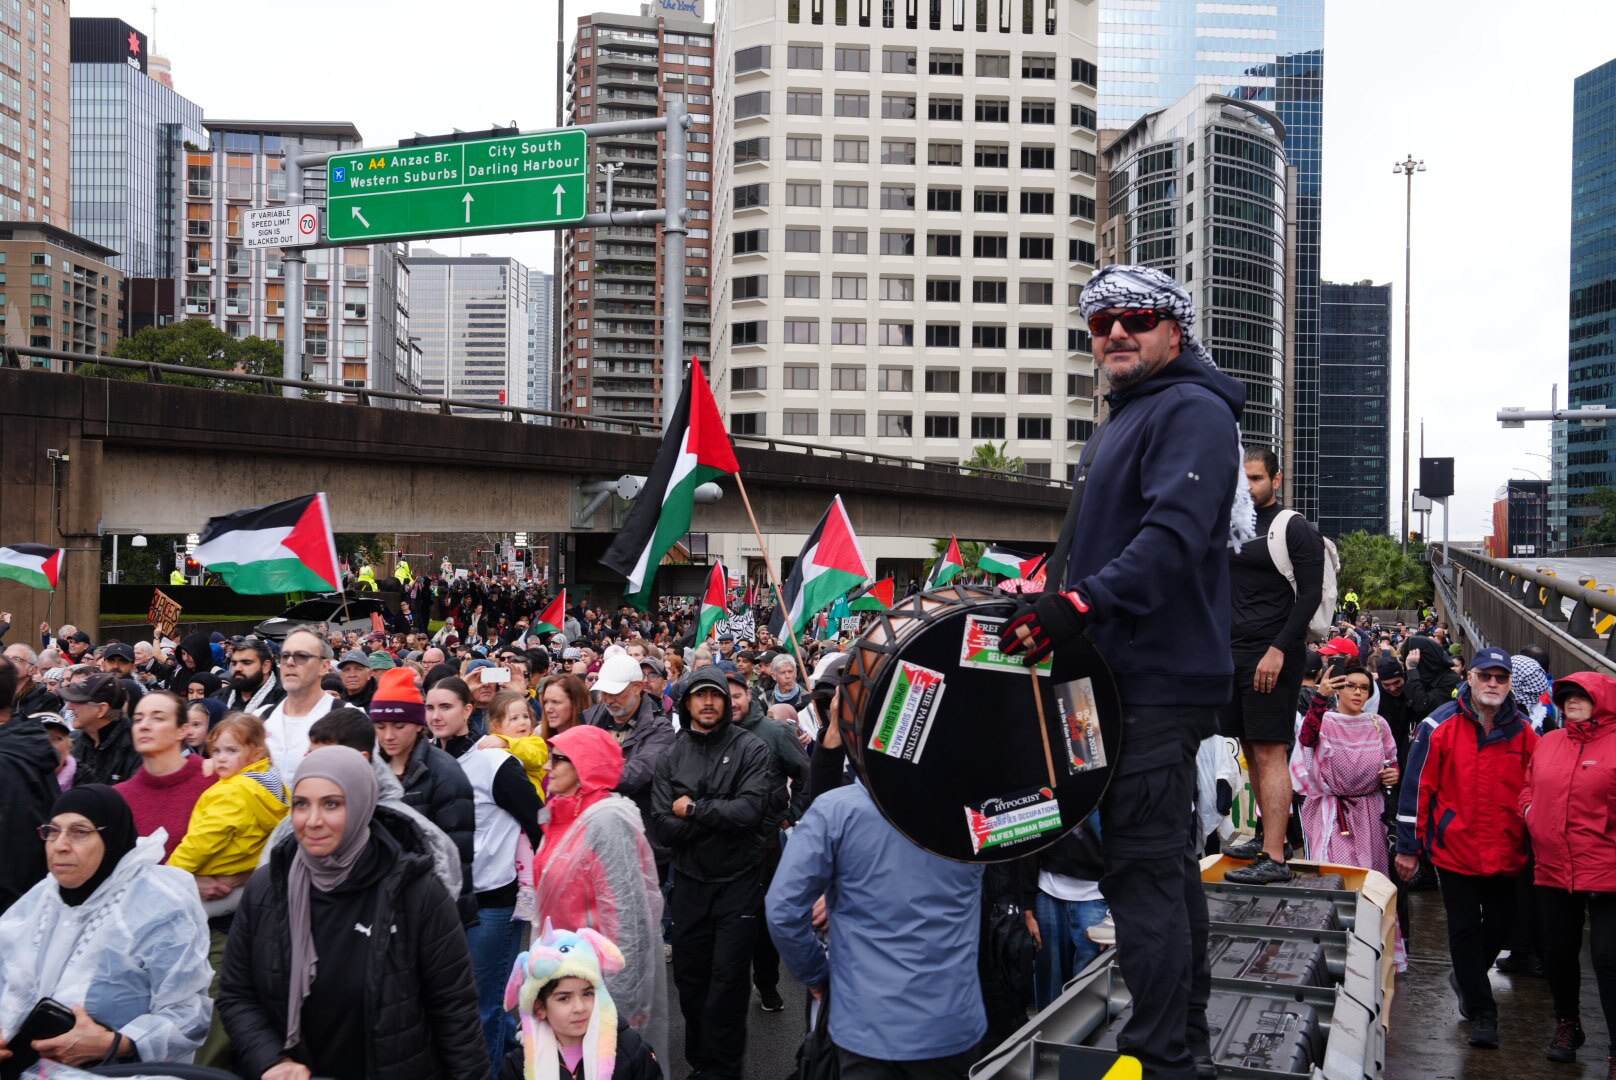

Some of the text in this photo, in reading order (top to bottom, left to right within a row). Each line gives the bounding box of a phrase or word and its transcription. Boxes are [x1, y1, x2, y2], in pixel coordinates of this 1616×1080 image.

[488, 139, 562, 158] City South
[350, 151, 452, 171] To A4 Anzac Br.
[469, 157, 580, 176] Darling Harbour
[350, 168, 457, 188] Western Suburbs
[251, 218, 290, 228] SPEED LIMIT
[258, 209, 291, 219] VARIABLE
[302, 219, 314, 229] 70
[248, 235, 293, 246] BLACKED OUT
[879, 683, 907, 746] UPHOLD EQUALITY
[1057, 697, 1067, 714] Break
[902, 681, 938, 761] FREE PALESTINE
[891, 713, 912, 756] SUPREMACY
[1088, 737, 1098, 755] 2023
[994, 793, 1041, 812] HYPOCRISY
[1018, 803, 1059, 819] OCCUPATIONS
[987, 816, 1062, 843] VILIFIES HUMAN RIGHTS
[1000, 832, 1042, 848] FREE PALESTINE
